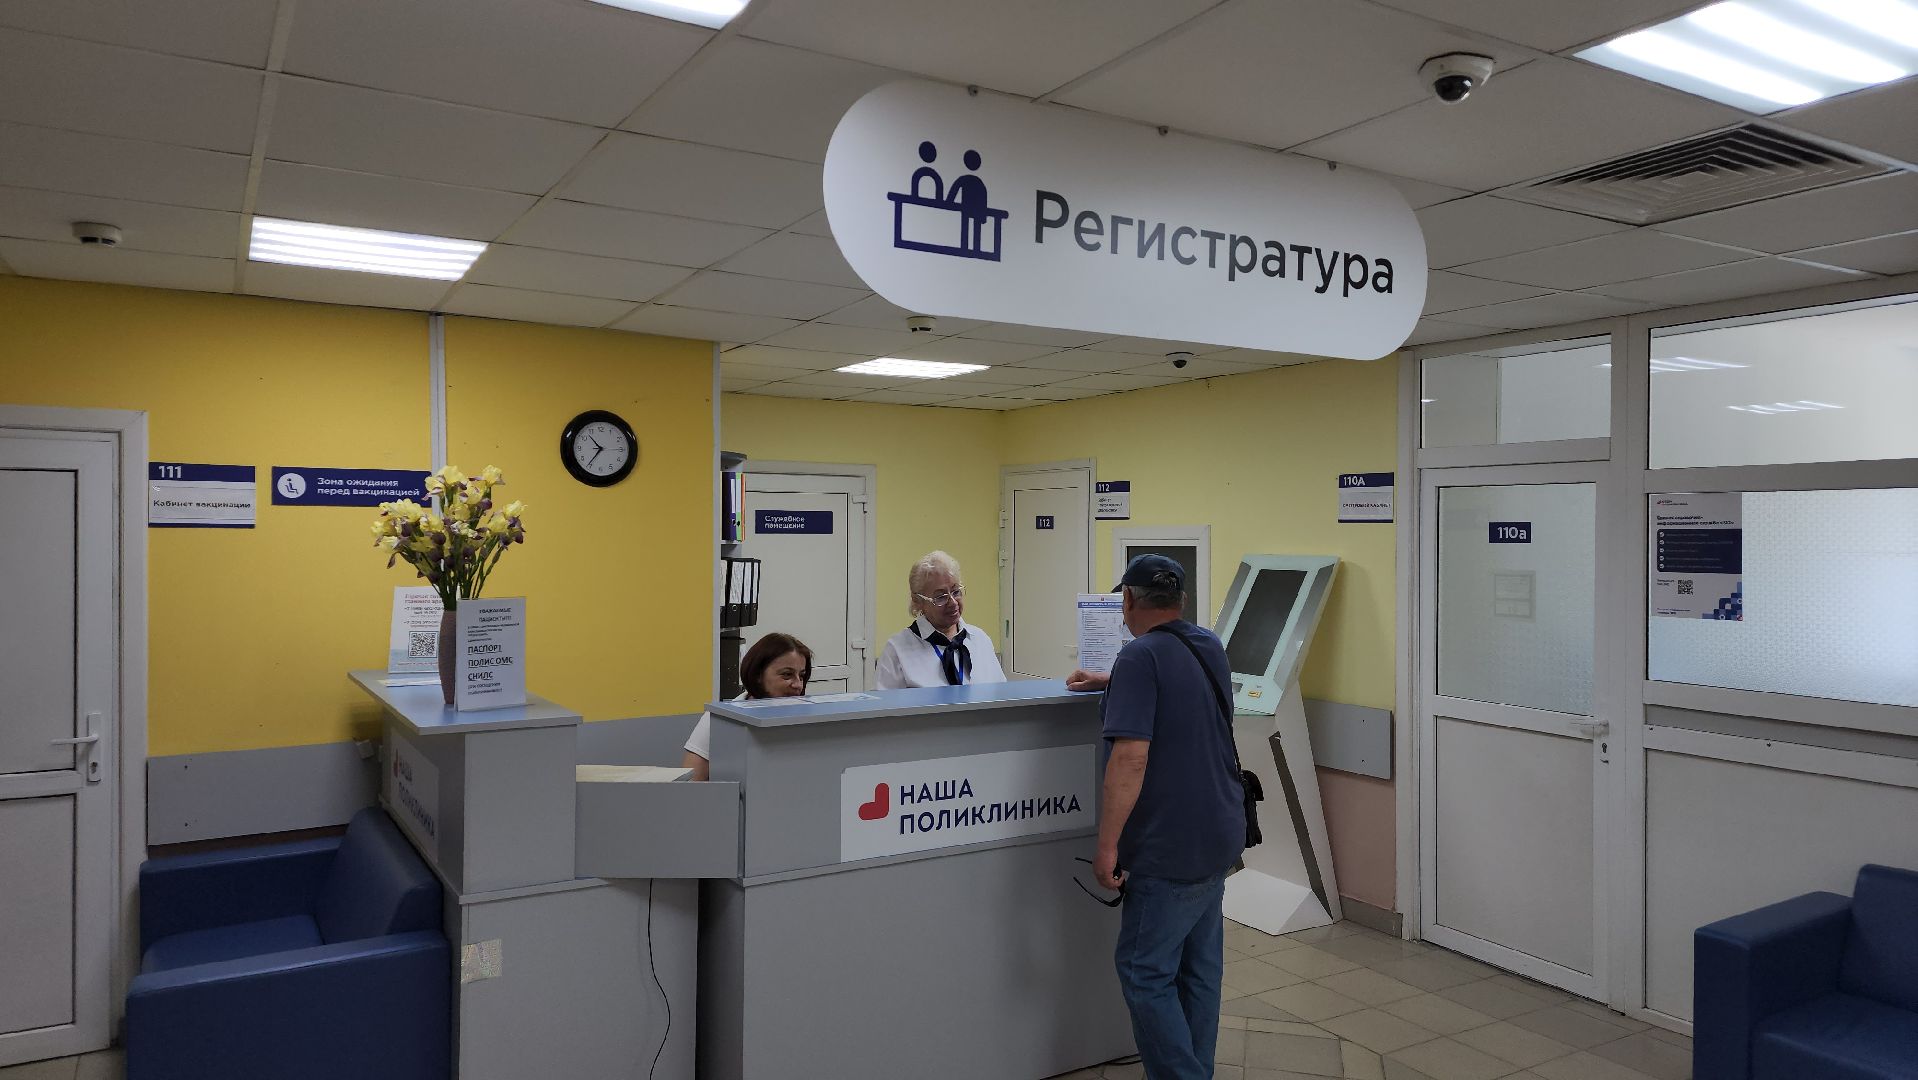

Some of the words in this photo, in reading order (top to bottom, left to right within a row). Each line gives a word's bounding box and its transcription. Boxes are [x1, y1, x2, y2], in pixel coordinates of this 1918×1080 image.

[1035, 189, 1394, 298] Регистратура
[158, 465, 182, 479] 111
[317, 477, 344, 486] Зона
[346, 477, 399, 489] ожидания
[1343, 475, 1366, 487] 110А
[317, 487, 351, 498] перед
[352, 487, 420, 499] вакцинацией
[1098, 483, 1110, 492] 112
[153, 499, 193, 508] Кабинет
[195, 501, 252, 510] вакцинации
[764, 515, 805, 523] Служебное
[1039, 518, 1051, 528] 112
[1497, 526, 1527, 540] 110а
[467, 644, 502, 655] ПАСПОРТ
[468, 658, 494, 668] ПОЛИС
[495, 656, 514, 665] ОМС
[467, 671, 494, 681] СНИЛС
[900, 778, 974, 806] НАША
[900, 794, 1082, 836] ПОЛИКЛИНИКА
